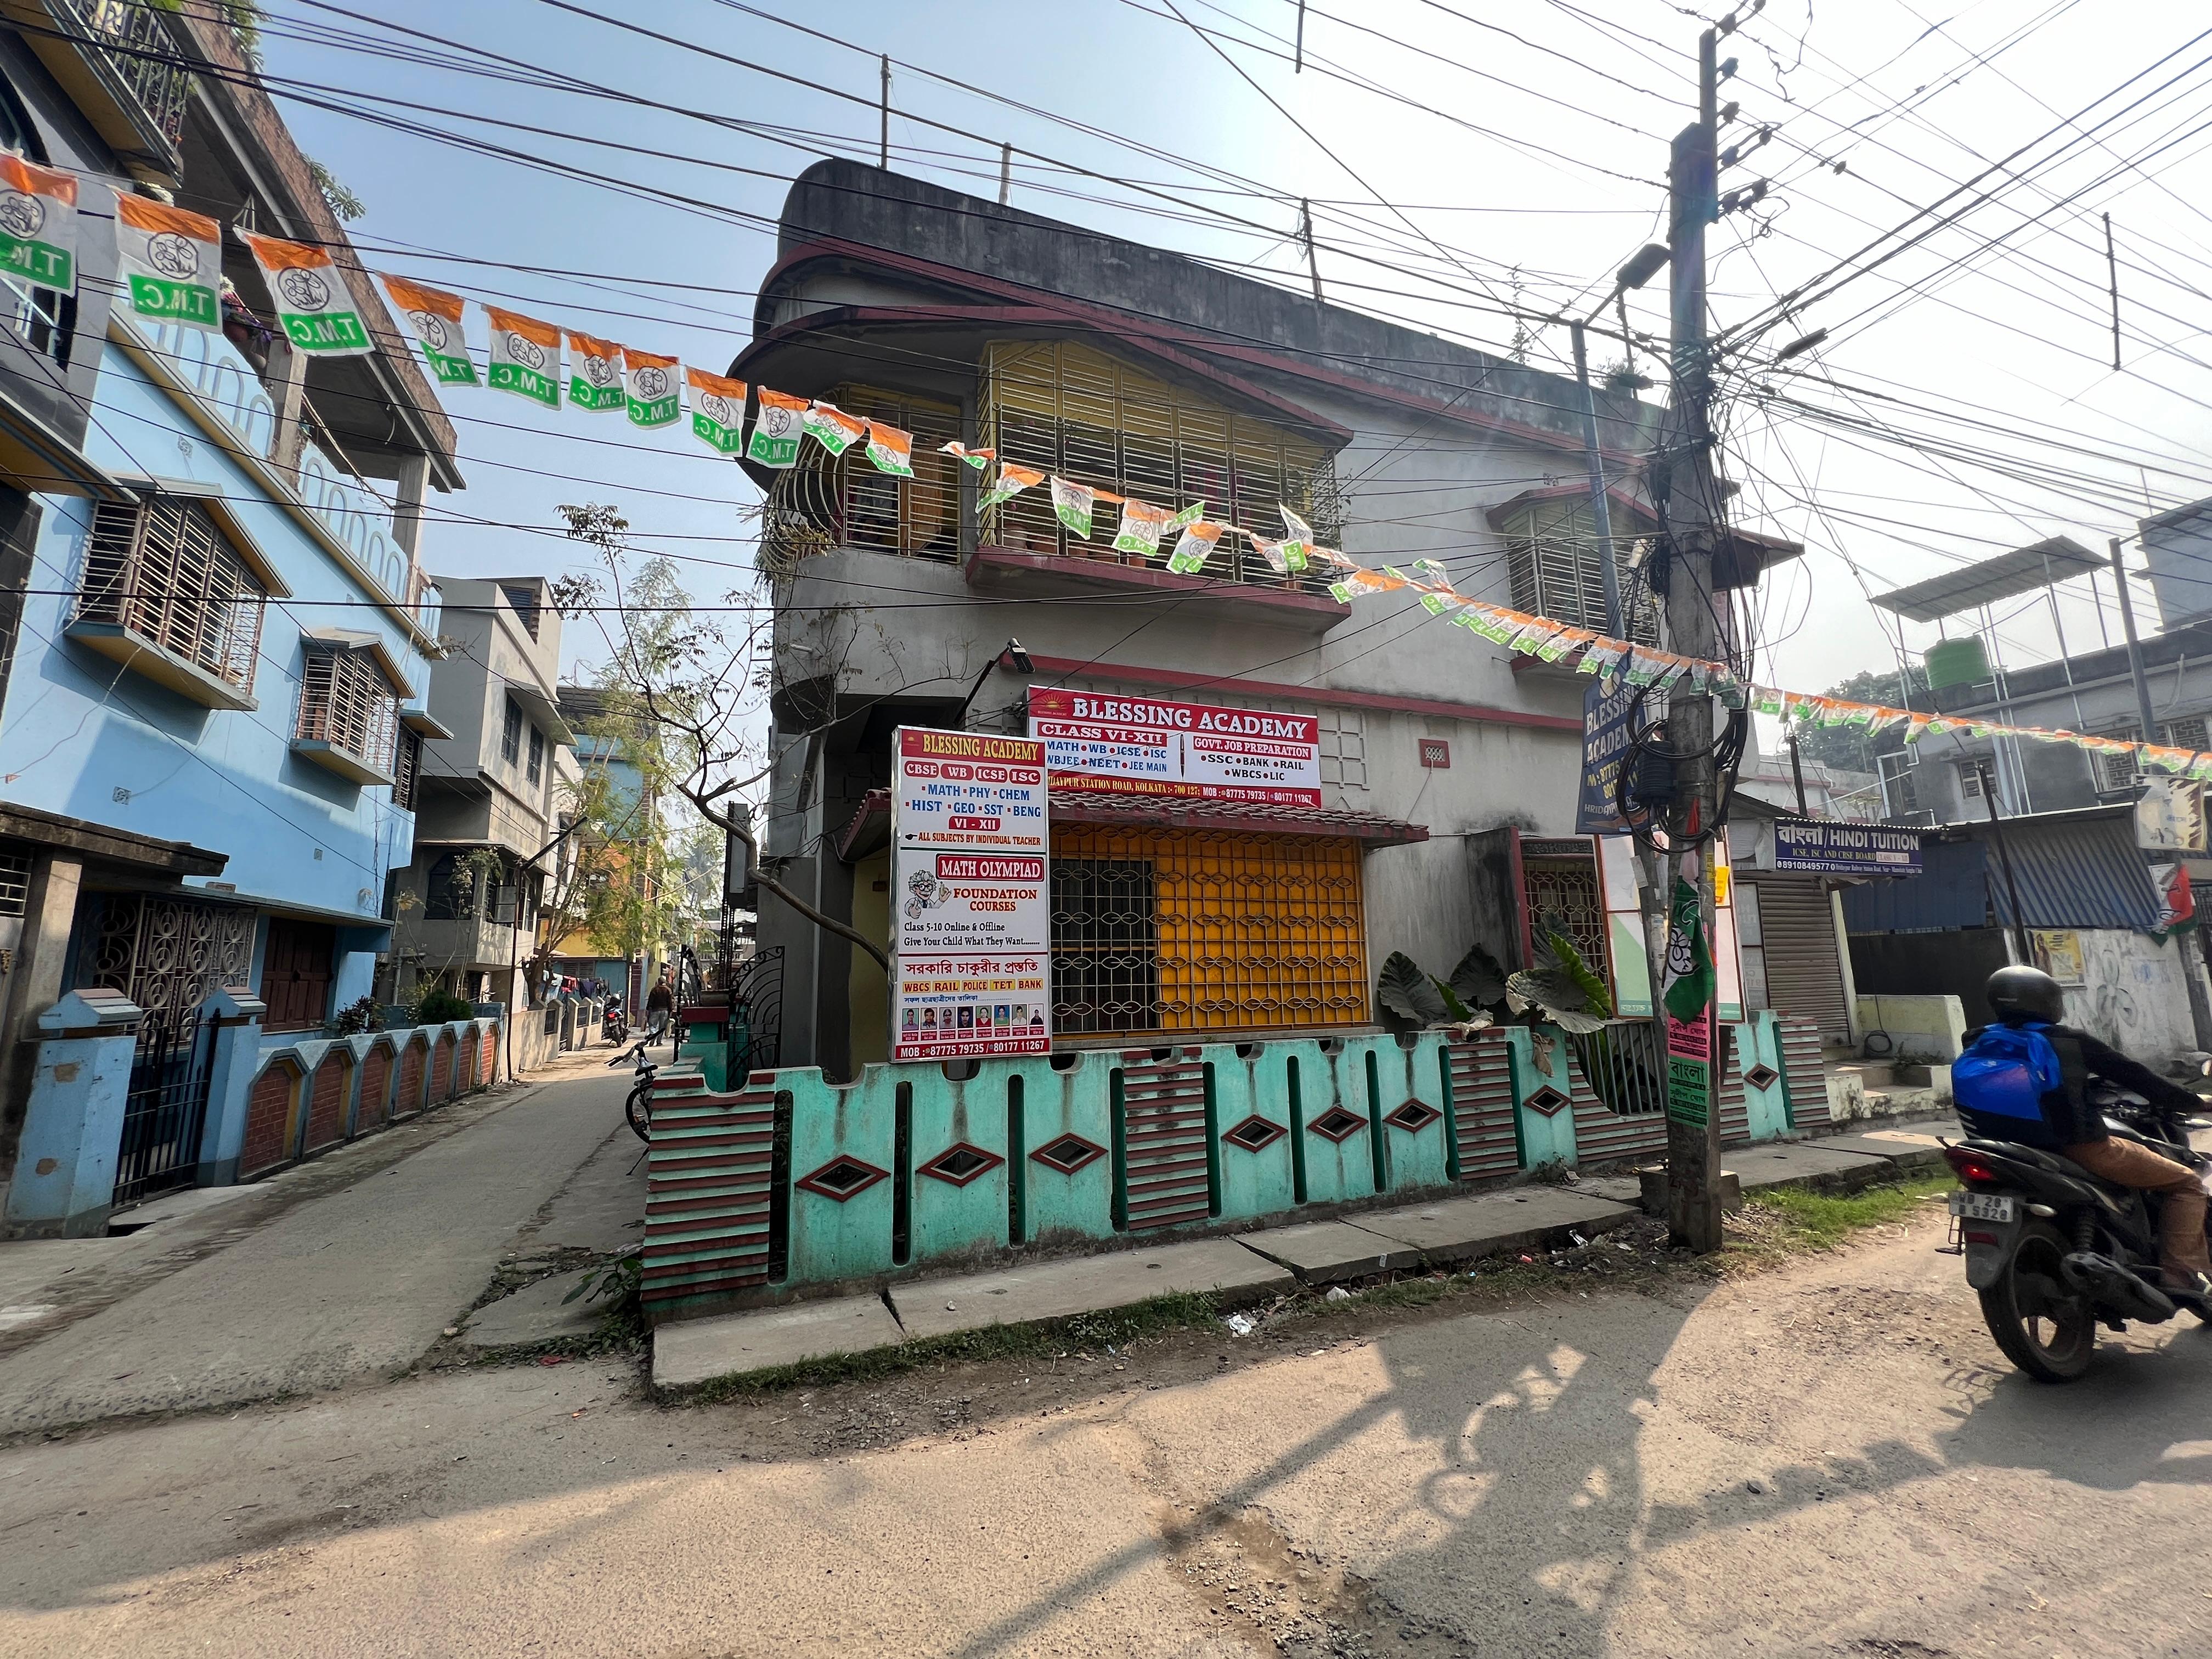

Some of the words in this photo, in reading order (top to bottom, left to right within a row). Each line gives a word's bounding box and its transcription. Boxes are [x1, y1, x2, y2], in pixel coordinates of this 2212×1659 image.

[1073, 698, 1192, 728] BLESSING
[1198, 712, 1308, 739] ACADEMY
[1041, 724, 1102, 739] CLASS
[1105, 729, 1163, 744] VI-XII
[923, 734, 980, 757] BLESSING
[983, 740, 1038, 761] ACADEMY
[1088, 744, 1107, 754] WB
[1117, 746, 1141, 757] ICSE
[1150, 749, 1166, 759] ISC
[1194, 737, 1223, 749] GOVT.
[1224, 741, 1243, 751] JOB
[1244, 742, 1309, 758] PREPARATION
[1088, 758, 1120, 769] NEET
[1129, 761, 1144, 771] JEE
[1146, 762, 1167, 772] MAIN
[1207, 754, 1233, 764] SSC
[1243, 757, 1269, 767] BANK
[1280, 760, 1304, 770] RAIL
[906, 763, 937, 776] CBSE
[947, 766, 967, 778] WB
[977, 769, 1005, 781] ICSE
[1012, 771, 1039, 782] ISC
[1232, 769, 1262, 779] WBCS
[1270, 772, 1285, 781] LIC
[928, 784, 960, 797] MATH
[969, 786, 991, 798] PHY
[999, 788, 1030, 800] CHEM
[1081, 778, 1111, 790] STATION
[1112, 780, 1134, 792] ROAD,
[1135, 782, 1166, 793] KOLKATA
[1174, 785, 1186, 794] 700
[1203, 787, 1217, 797] MOB
[1226, 788, 1245, 798] 87775
[1247, 790, 1266, 800] 79735
[1274, 792, 1293, 802] 80177
[1294, 794, 1312, 804] 11267
[912, 799, 943, 812] HIST
[953, 803, 975, 814] GEO
[984, 804, 1003, 815] SST
[1013, 806, 1041, 817] BENG
[955, 818, 967, 828] VI
[979, 819, 996, 830] XII
[918, 832, 930, 841] ALL
[933, 833, 964, 843] SUBJECTS
[966, 834, 974, 843] BY
[976, 834, 1011, 845] INDIVIDUAL
[1012, 836, 1041, 845] TEACHER
[1871, 832, 1919, 850] TUITION
[1792, 848, 1809, 857] ICSE,
[1824, 850, 1837, 859] AND
[1838, 851, 1853, 859] CBSE
[1855, 852, 1876, 860] BOARD
[941, 860, 977, 877] MATH
[980, 861, 1041, 878] OLYMPIAD
[953, 888, 1037, 900] FOUNDATION
[970, 901, 1016, 912] COURSES
[905, 921, 924, 932] Class
[926, 922, 942, 932] 5-10
[944, 922, 970, 932] Online
[979, 922, 1005, 932] Offline
[904, 937, 922, 946] Give
[923, 937, 940, 946] Your
[943, 936, 962, 946] Child
[965, 936, 984, 945] What
[986, 936, 1003, 947] They
[905, 960, 953, 975] সরকারি
[956, 958, 1001, 977] চাকুরীর
[905, 983, 930, 992] WBCS
[934, 982, 959, 992] RAIL
[963, 981, 988, 991] POLICE
[993, 980, 1013, 990] TET
[1018, 980, 1042, 989] BANK
[901, 1047, 919, 1057] MOB
[930, 1045, 956, 1056] 87775
[959, 1043, 984, 1054] 79735
[994, 1042, 1018, 1052] 80177
[1021, 1040, 1044, 1051] 11267
[1669, 1061, 1705, 1083] বাংলা
